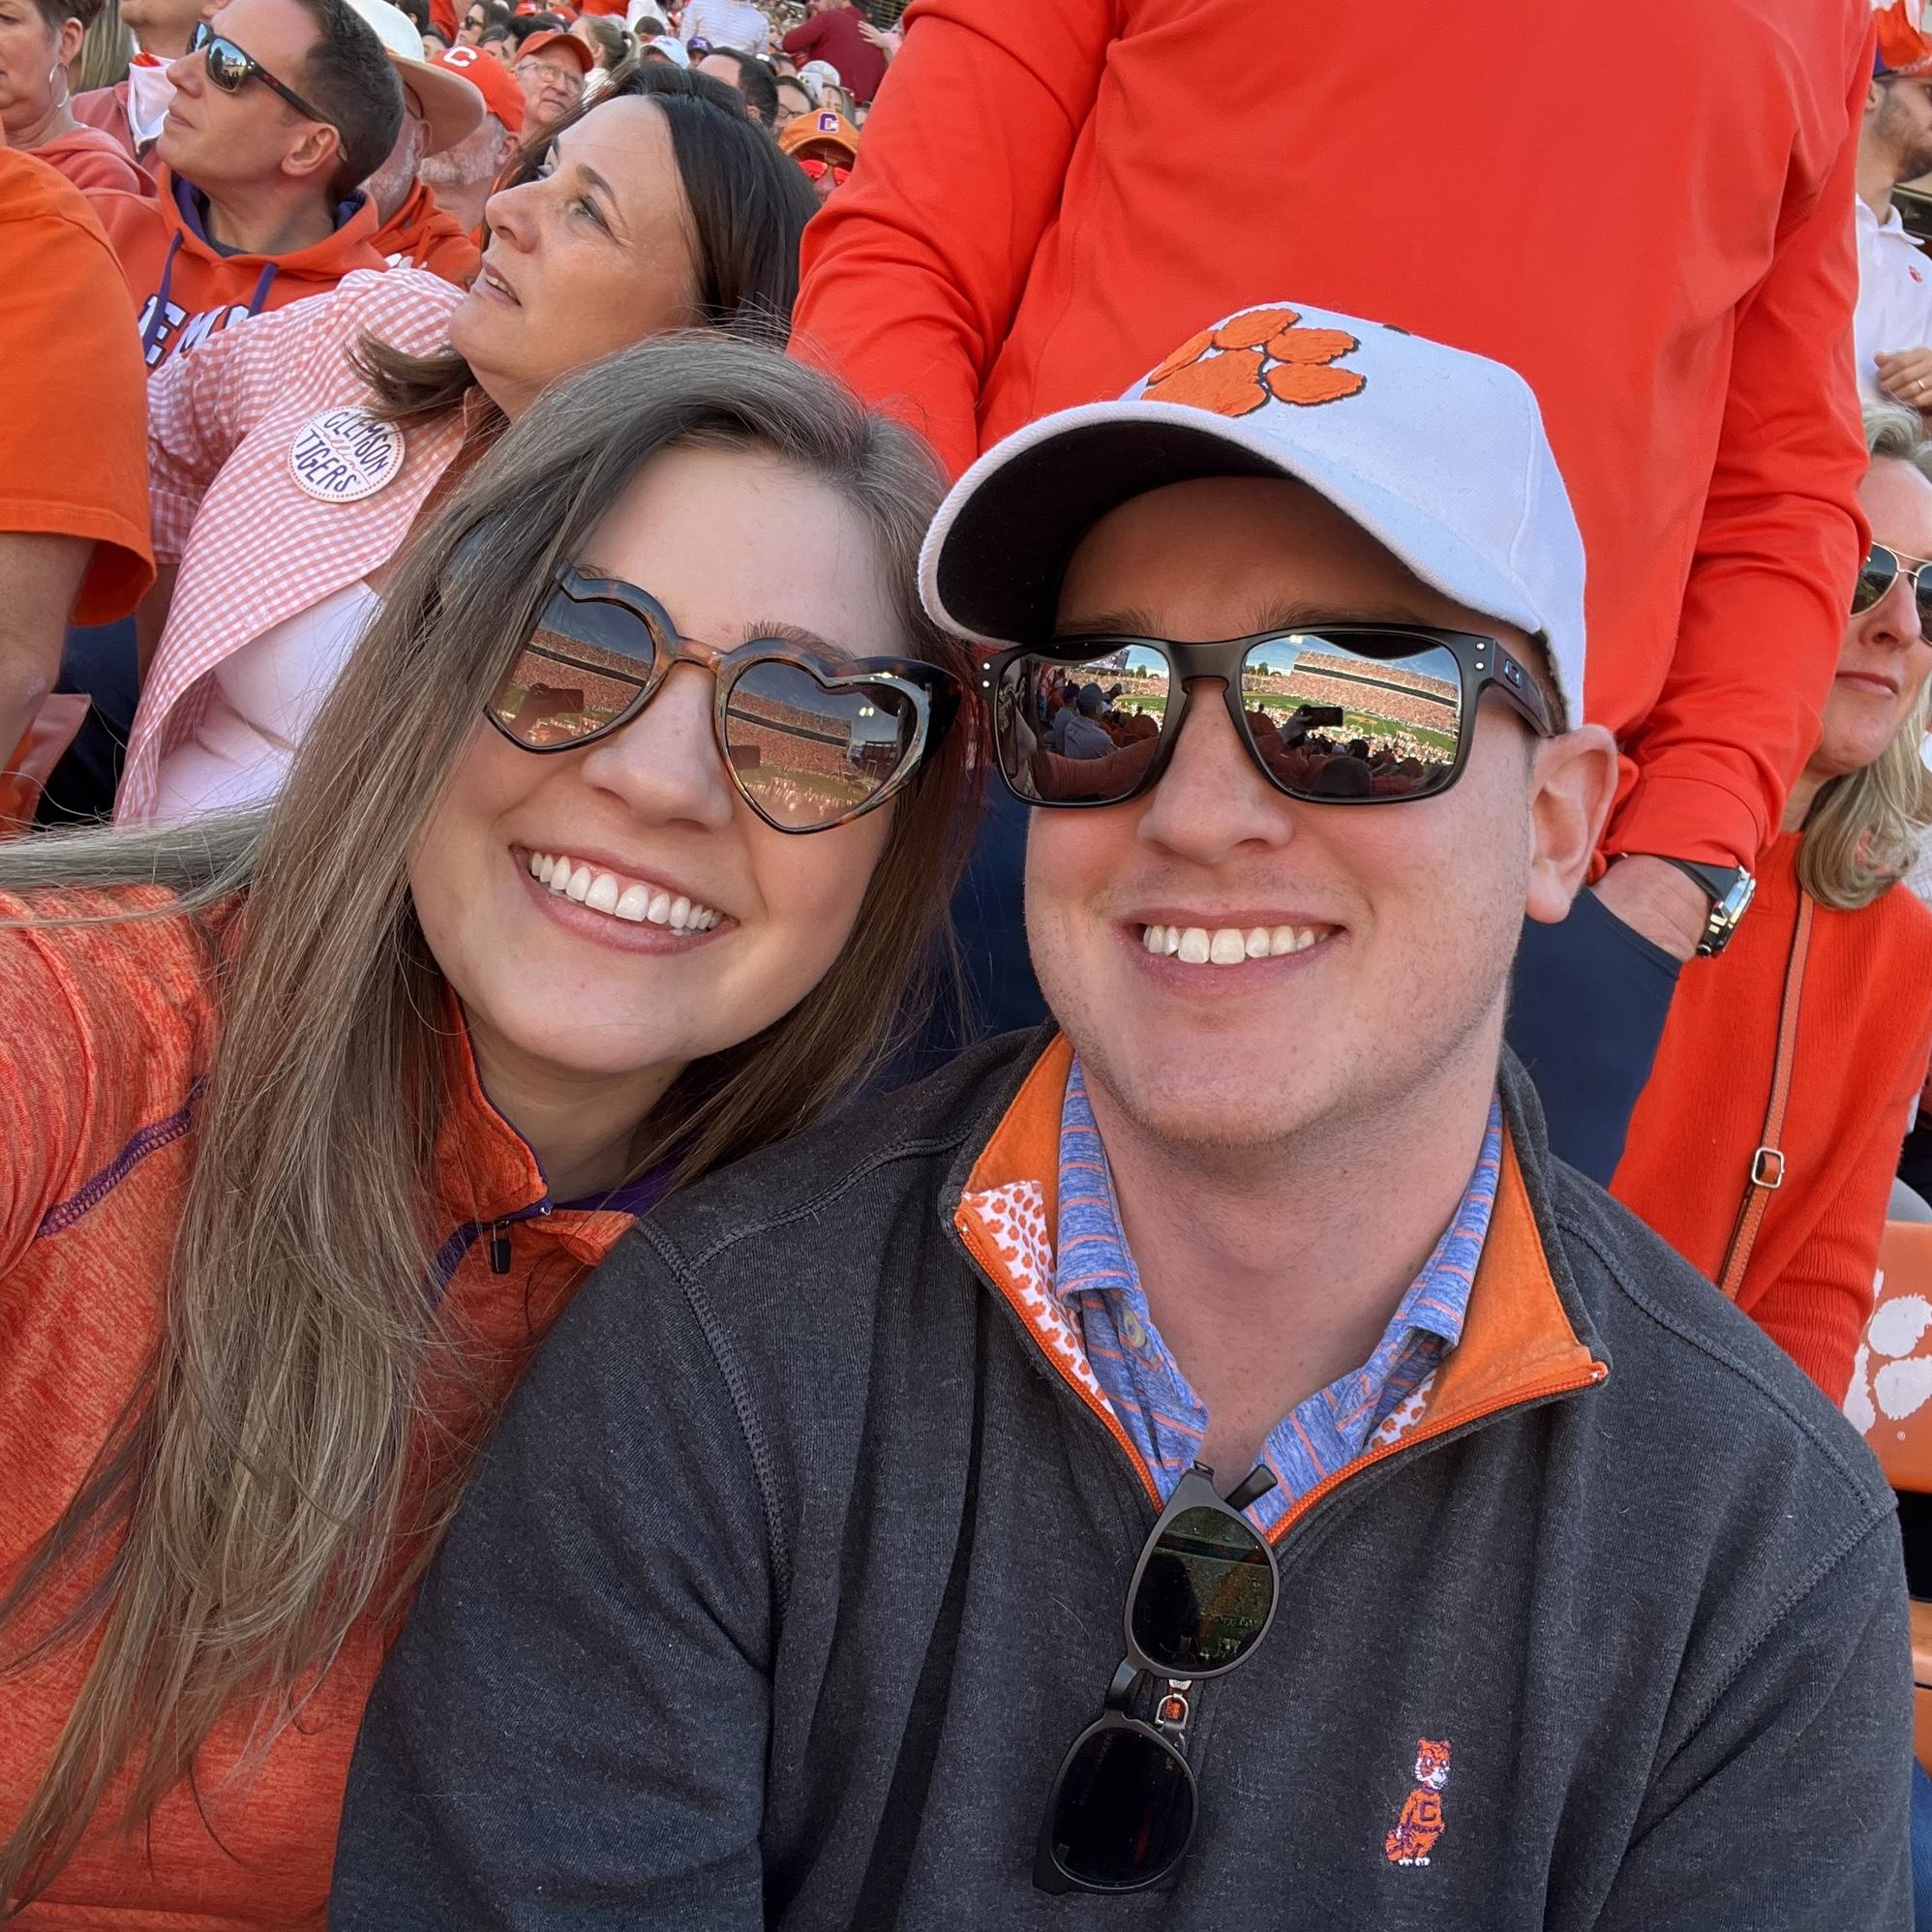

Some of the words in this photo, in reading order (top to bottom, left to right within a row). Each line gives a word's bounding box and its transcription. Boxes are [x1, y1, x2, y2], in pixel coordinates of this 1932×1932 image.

[442, 45, 479, 68] C
[818, 111, 839, 134] C
[324, 411, 391, 476] CLEMSON
[294, 428, 357, 492] TIGERS
[1420, 1799, 1437, 1822] C
